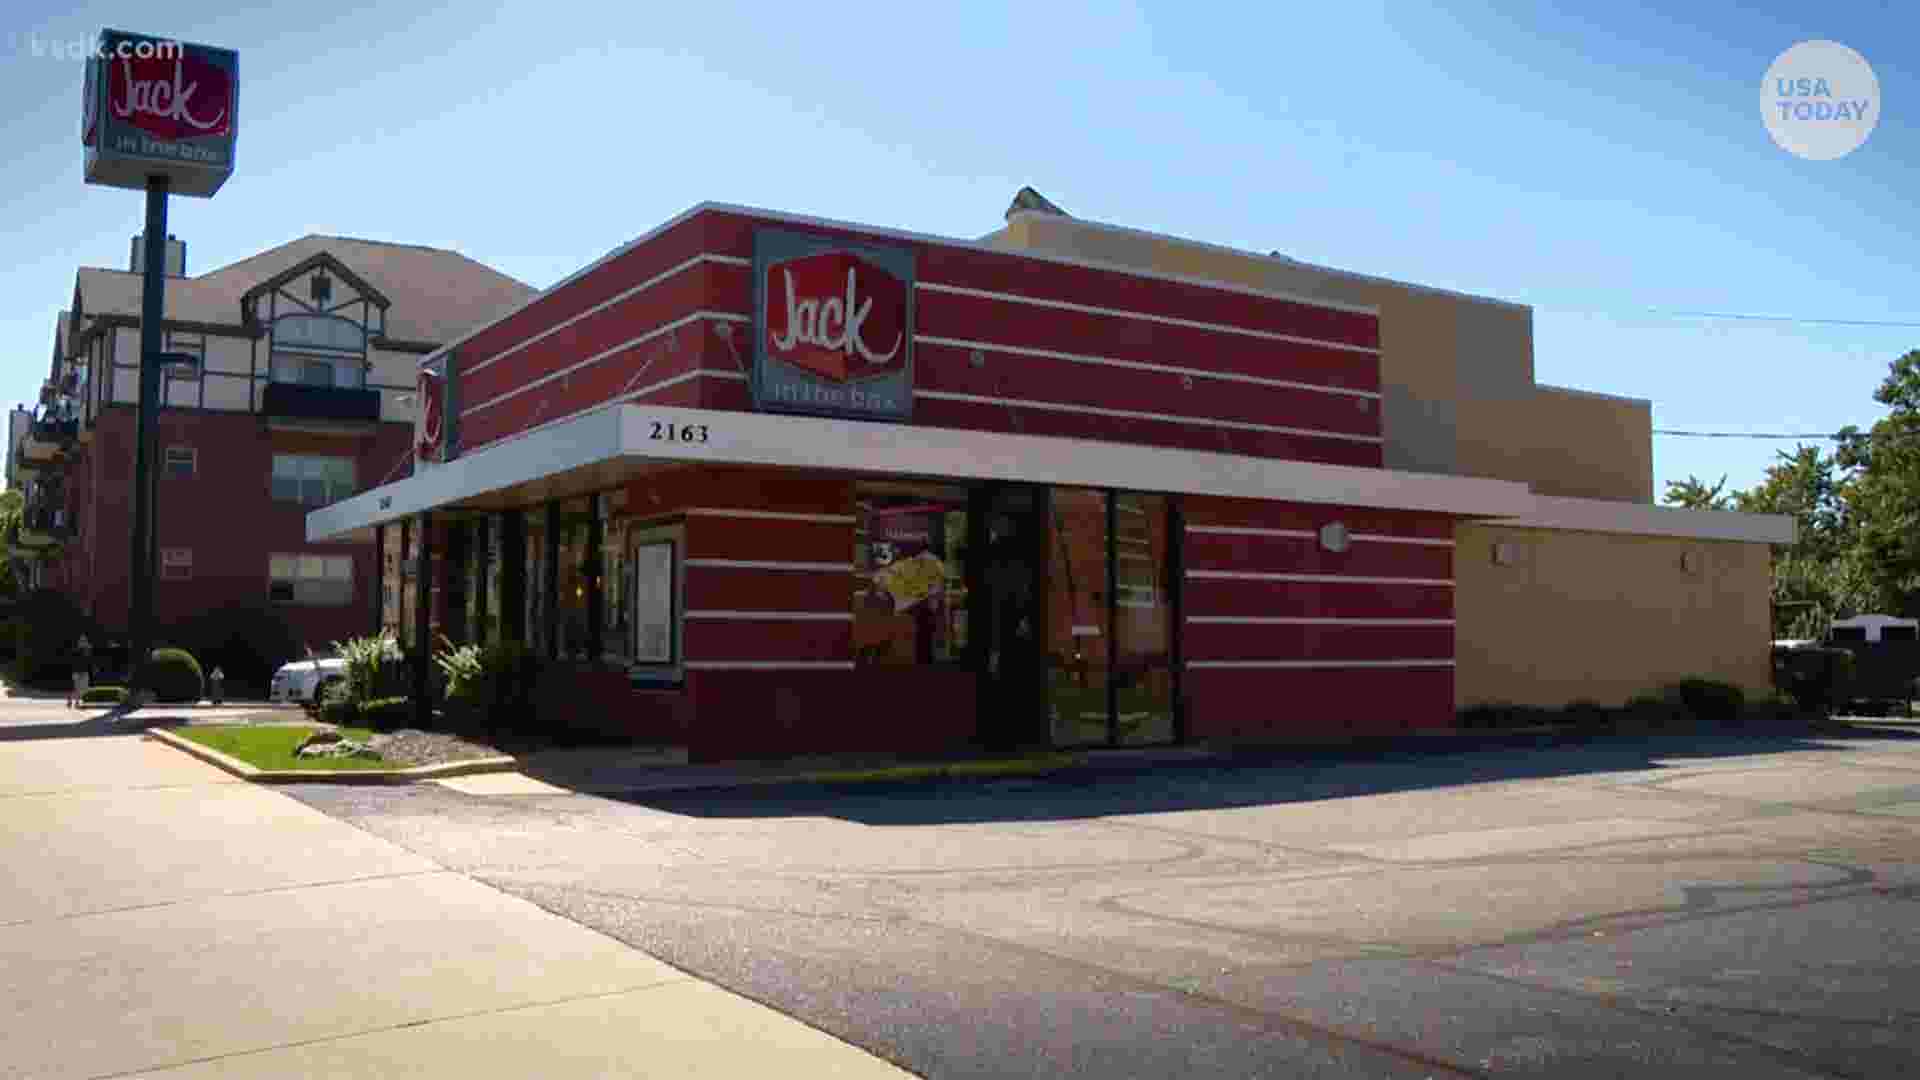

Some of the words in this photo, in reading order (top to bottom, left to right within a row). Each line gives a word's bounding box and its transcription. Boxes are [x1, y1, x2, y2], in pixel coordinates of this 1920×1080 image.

[111, 60, 225, 129] Jack
[772, 266, 902, 363] Jack
[648, 421, 709, 443] 2163
